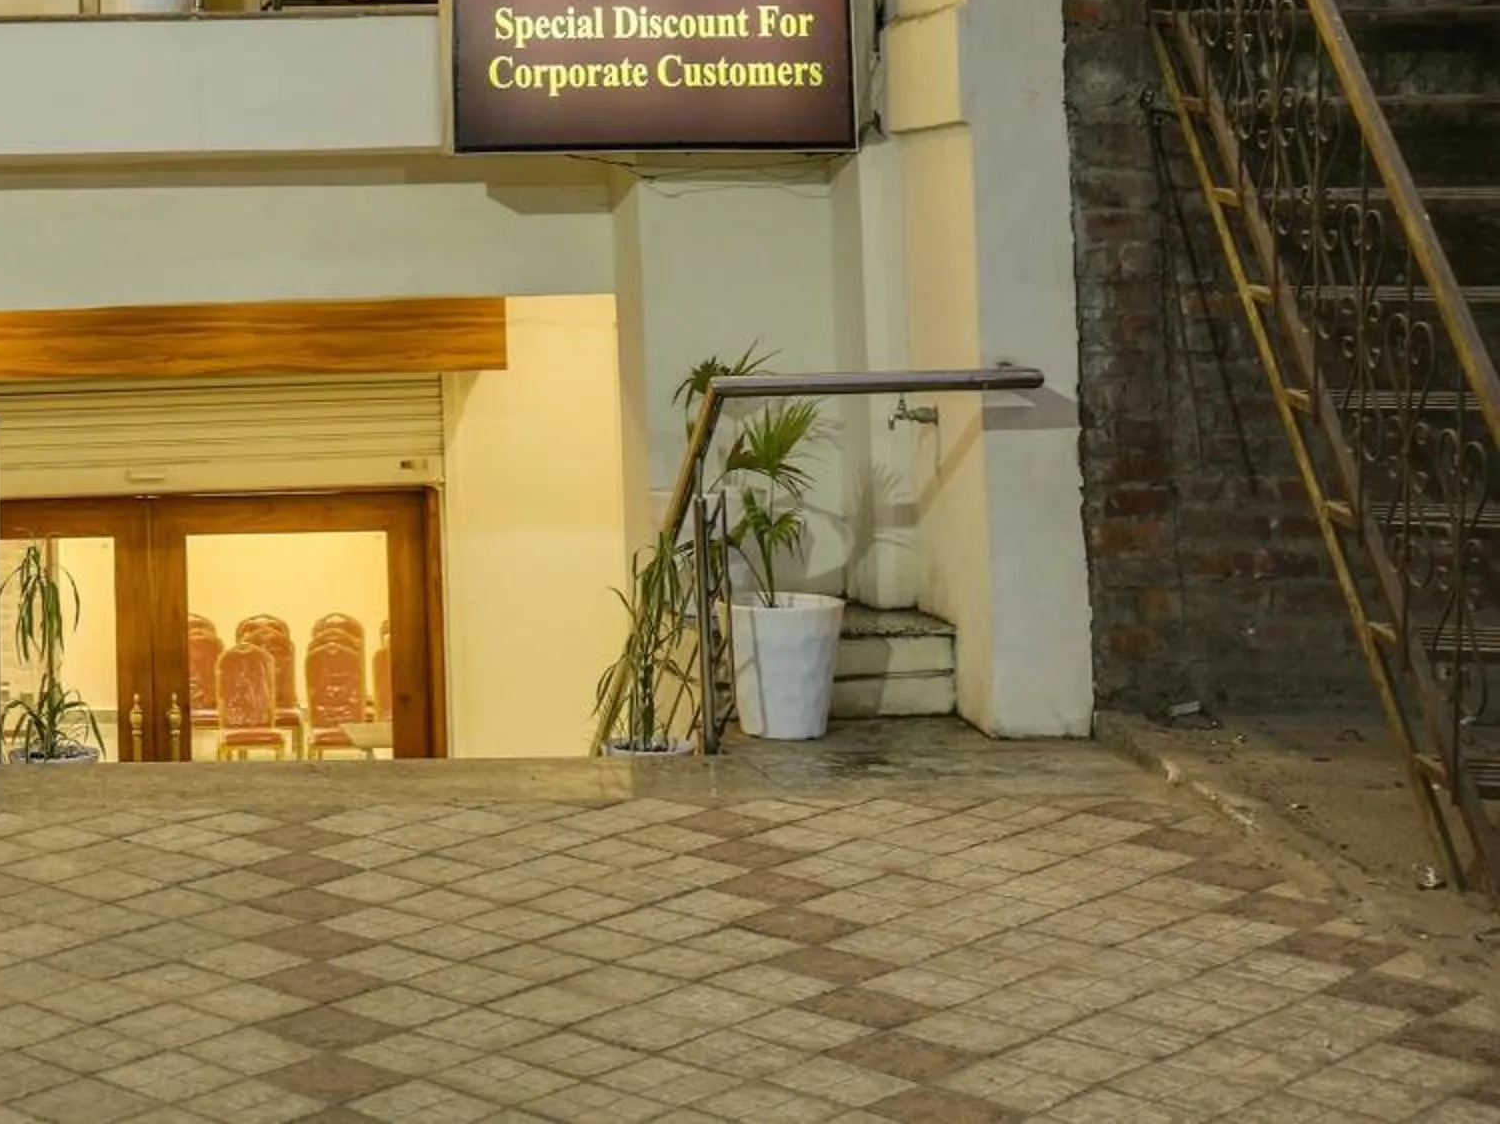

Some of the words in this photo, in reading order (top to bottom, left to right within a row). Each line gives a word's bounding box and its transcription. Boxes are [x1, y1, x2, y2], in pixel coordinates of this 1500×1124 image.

[494, 6, 605, 48] Special
[612, 5, 749, 40] Discount
[758, 5, 815, 37] For
[489, 56, 649, 97] Corporate
[657, 55, 824, 88] Customers
